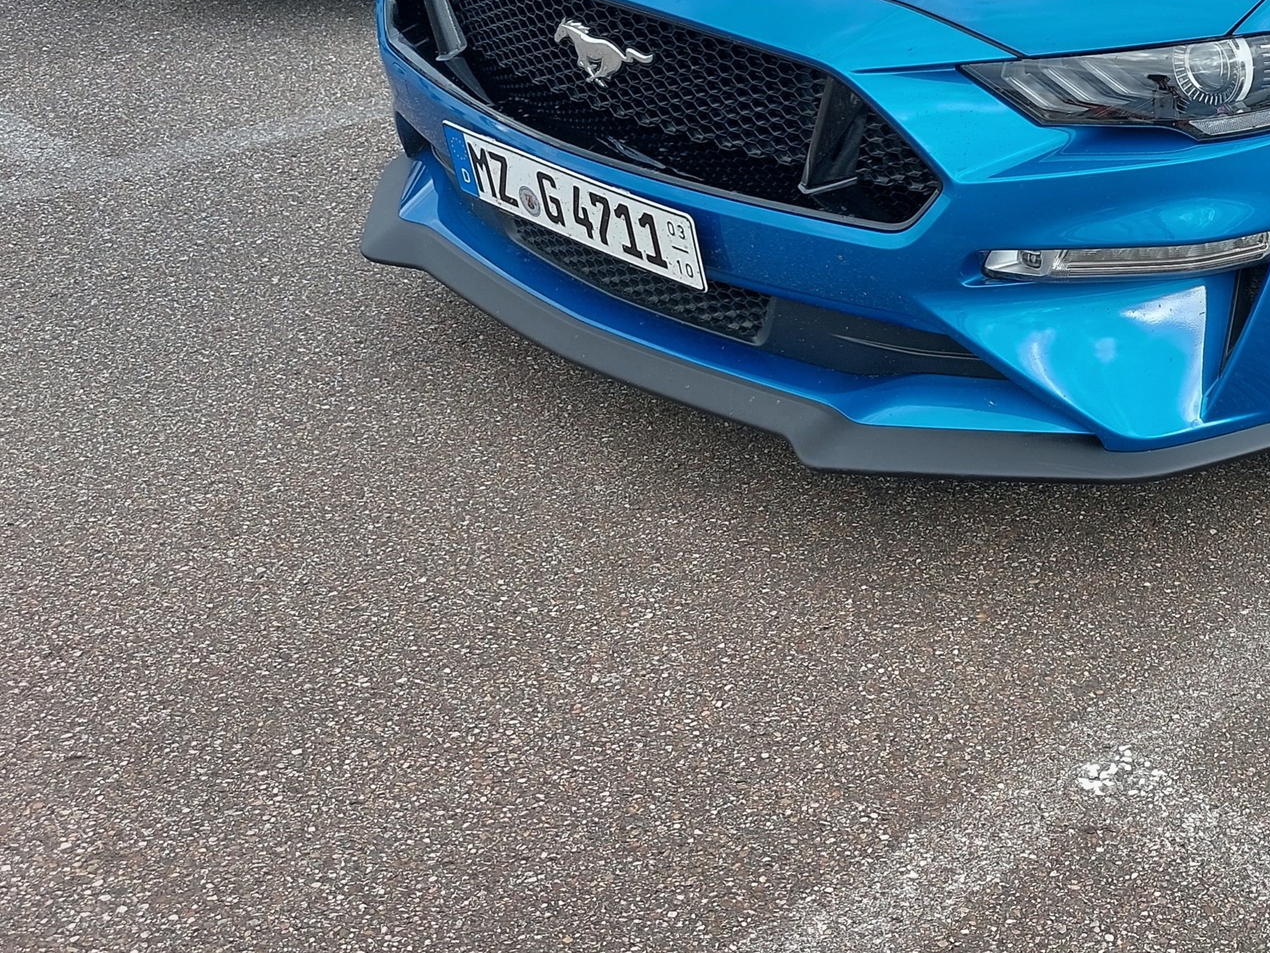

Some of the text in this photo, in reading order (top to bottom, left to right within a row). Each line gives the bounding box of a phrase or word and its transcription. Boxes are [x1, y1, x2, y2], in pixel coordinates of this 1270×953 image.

[461, 168, 471, 184] D
[466, 142, 668, 270] MZ G 4711
[666, 220, 686, 240] 03
[676, 259, 694, 279] 10
